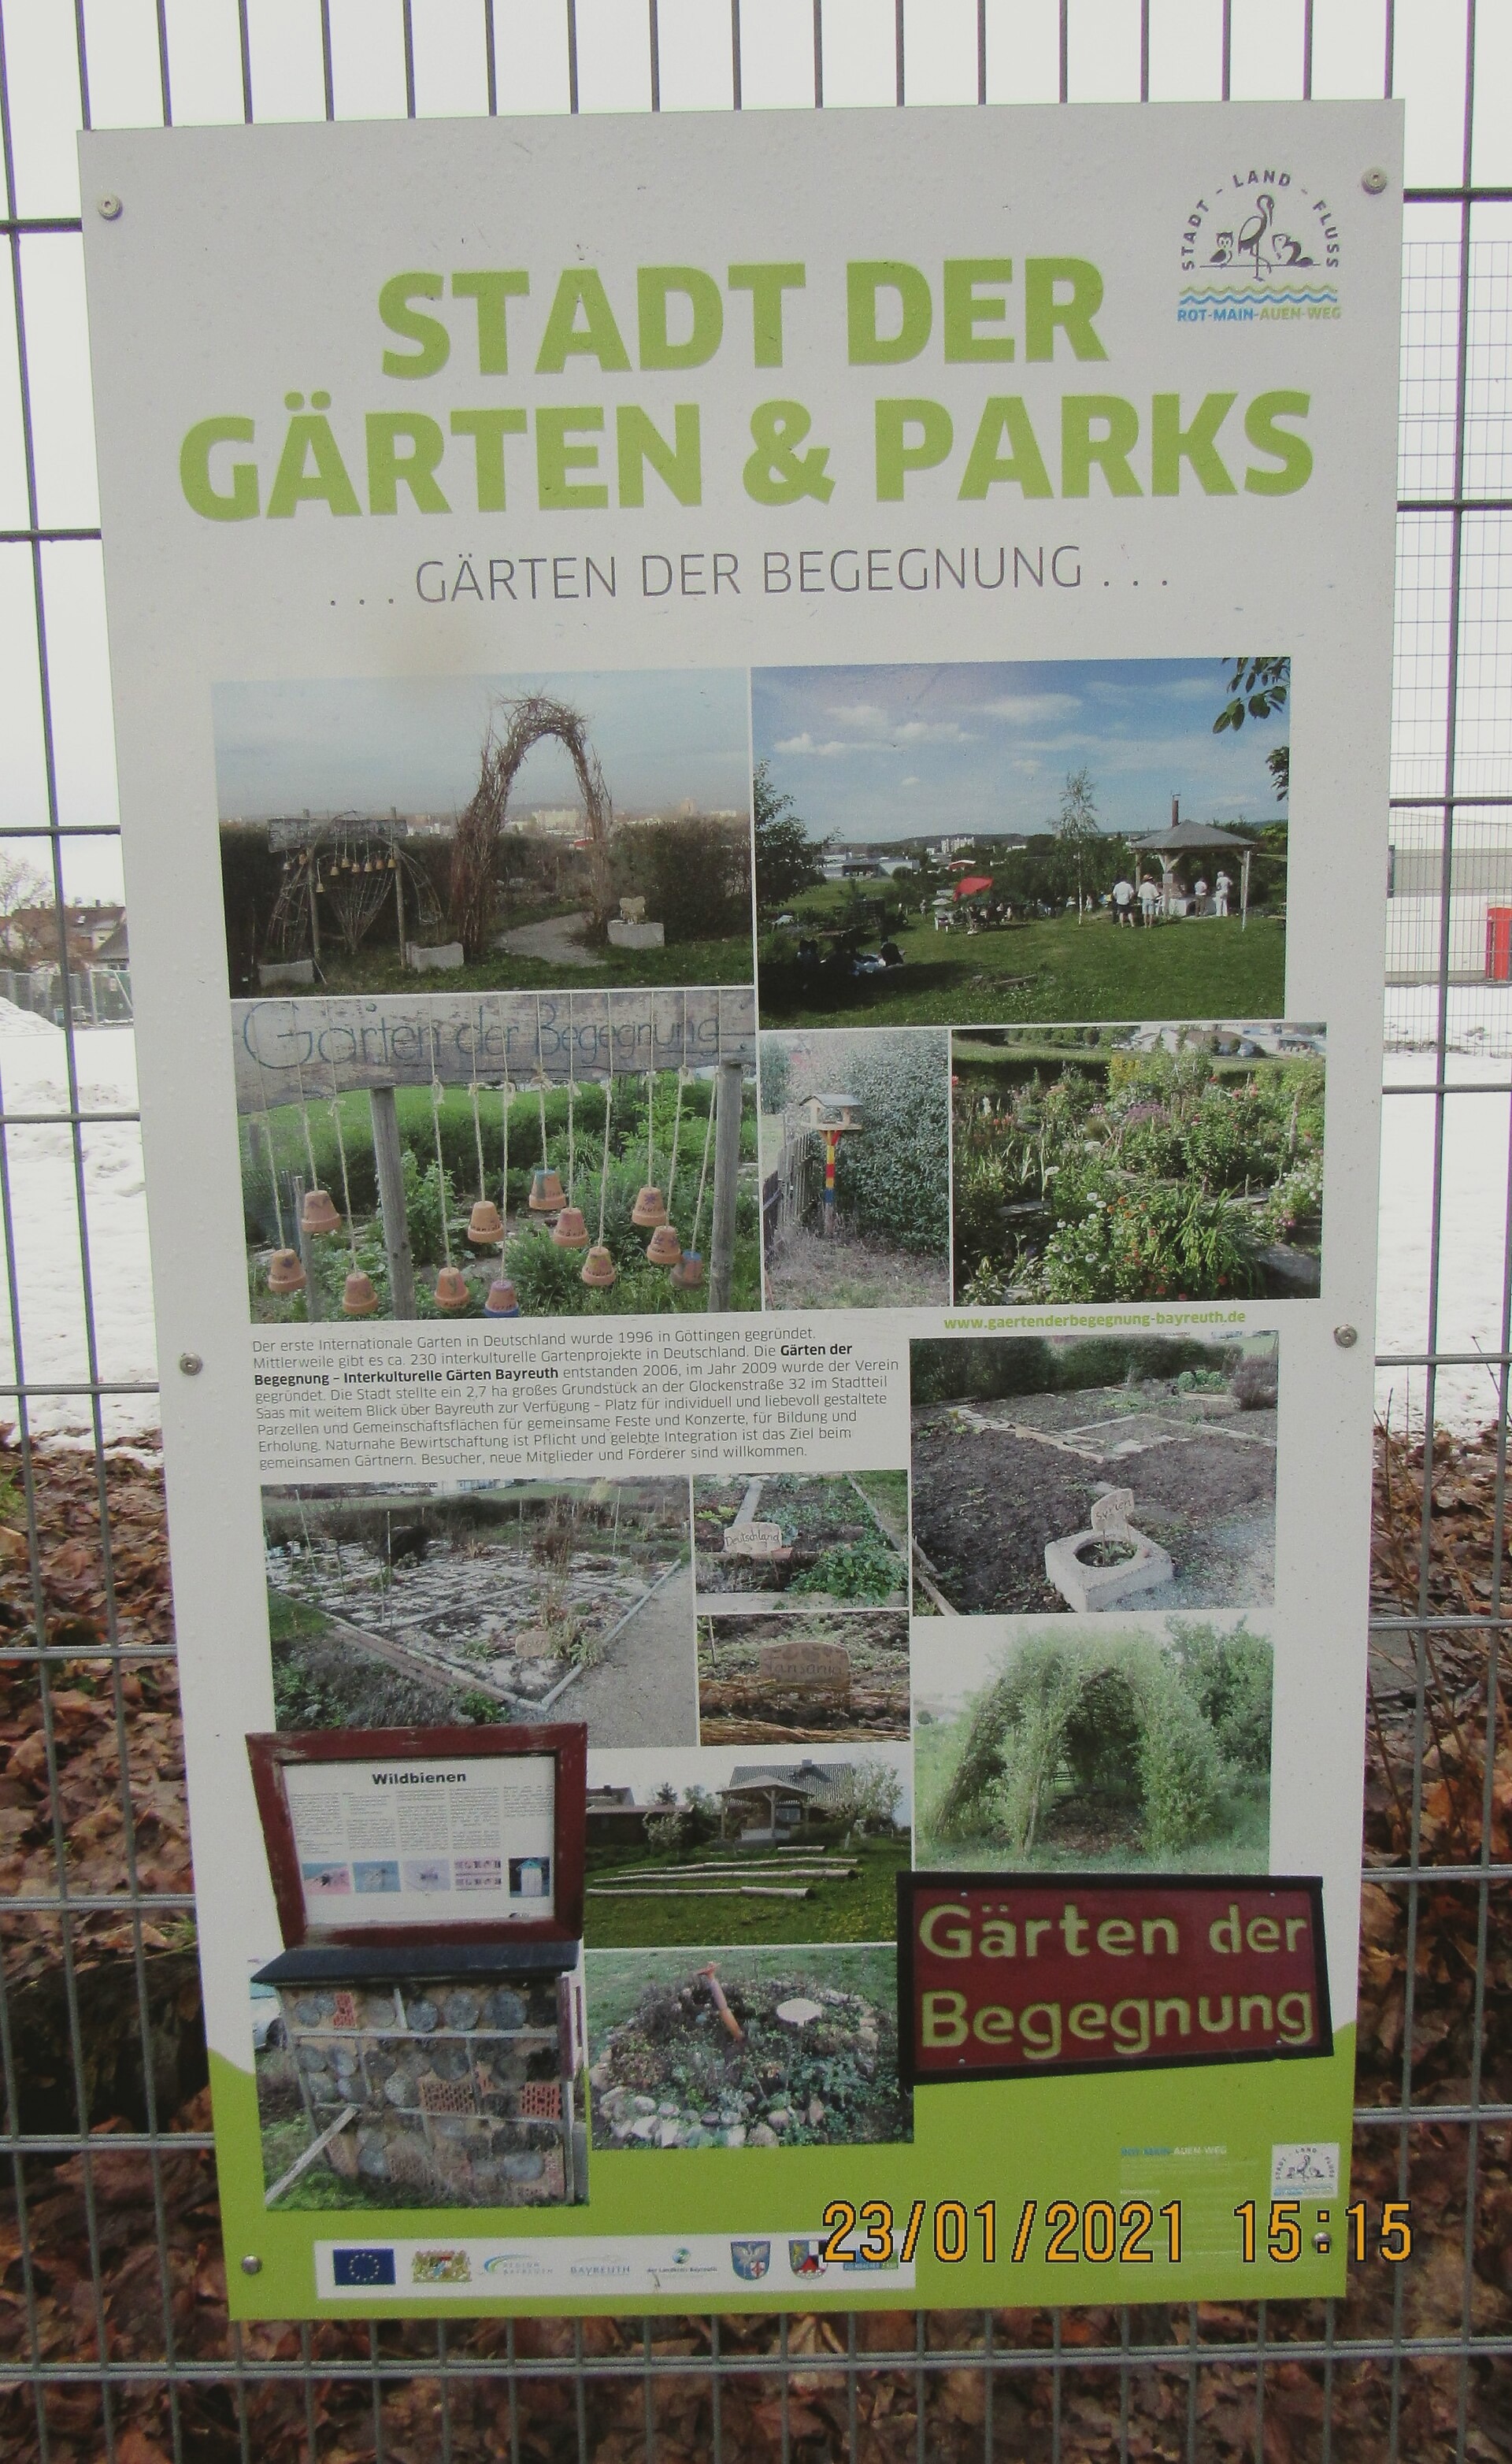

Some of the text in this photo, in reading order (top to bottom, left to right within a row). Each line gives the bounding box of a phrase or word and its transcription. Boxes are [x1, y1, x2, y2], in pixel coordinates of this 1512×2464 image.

[1232, 169, 1292, 188] LAND
[378, 256, 1108, 378] STADT DER
[179, 388, 1314, 521] GÄRTEN & PARKS
[416, 544, 1082, 604] GÄRTEN DER BEGEGNUNG
[458, 1005, 519, 1057] der
[536, 1002, 721, 1065] Begegnung
[943, 1310, 1246, 1329] www.gaertenderbegegnung-bayreuth.de
[252, 1328, 816, 1351] Der erste Internationale Garten in Deutschland wurde 1996 in Göttingen gegründet.
[253, 1343, 854, 1369] Mittlerweile gibt es ca. 230 interkulturelle Gartenprojekte in Deutschland. Die Gärten der
[254, 1372, 330, 1388] Begegnung
[343, 1369, 443, 1383] Interkulturelle
[446, 1369, 491, 1380] Gärten
[495, 1367, 558, 1383] Bayreuth
[563, 1365, 638, 1378] entstanden
[643, 1364, 681, 1378] 2006,
[687, 1364, 702, 1375] im
[707, 1363, 736, 1374] Jahr
[742, 1362, 777, 1373] 2009
[782, 1361, 825, 1373] wurde
[828, 1360, 850, 1372] der
[855, 1359, 899, 1371] Verein
[255, 1376, 888, 1404] gegründet. Die Stadt stellte ein 2,7 ha großes Grundstück an der Glockenstraße 32 im Stadtteil
[256, 1406, 285, 1417] Saas
[289, 1406, 309, 1417] mit
[316, 1404, 361, 1417] weitem
[366, 1403, 397, 1415] Blick
[401, 1402, 430, 1414] über
[435, 1402, 494, 1417] Bayreuth
[498, 1402, 518, 1412] zur
[522, 1399, 590, 1415] Verfügung
[606, 1399, 637, 1410] Platz
[641, 1398, 660, 1409] für
[665, 1396, 732, 1409] individuell
[736, 1395, 761, 1407] und
[765, 1394, 820, 1406] liebevoll
[824, 1393, 888, 1408] gestaltete
[258, 1410, 857, 1434] Parzellen und Gemeinschaftsflächen für gemeinsame Feste und Konzerte, für Bildung und
[258, 1427, 852, 1454] Erholung. Naturnahe Bewirtschaftung ist Pflicht und gelebte Integration ist das Ziel beim
[259, 1444, 807, 1470] gemeinsamen Gärtnern. Besucher, neue Mitglieder und Förderer sind willkommen.
[724, 1528, 780, 1547] Deutschland
[372, 1772, 467, 1786] Wildbienen
[918, 1903, 1307, 1959] Gärten der
[921, 1990, 1314, 2061] Begegnung
